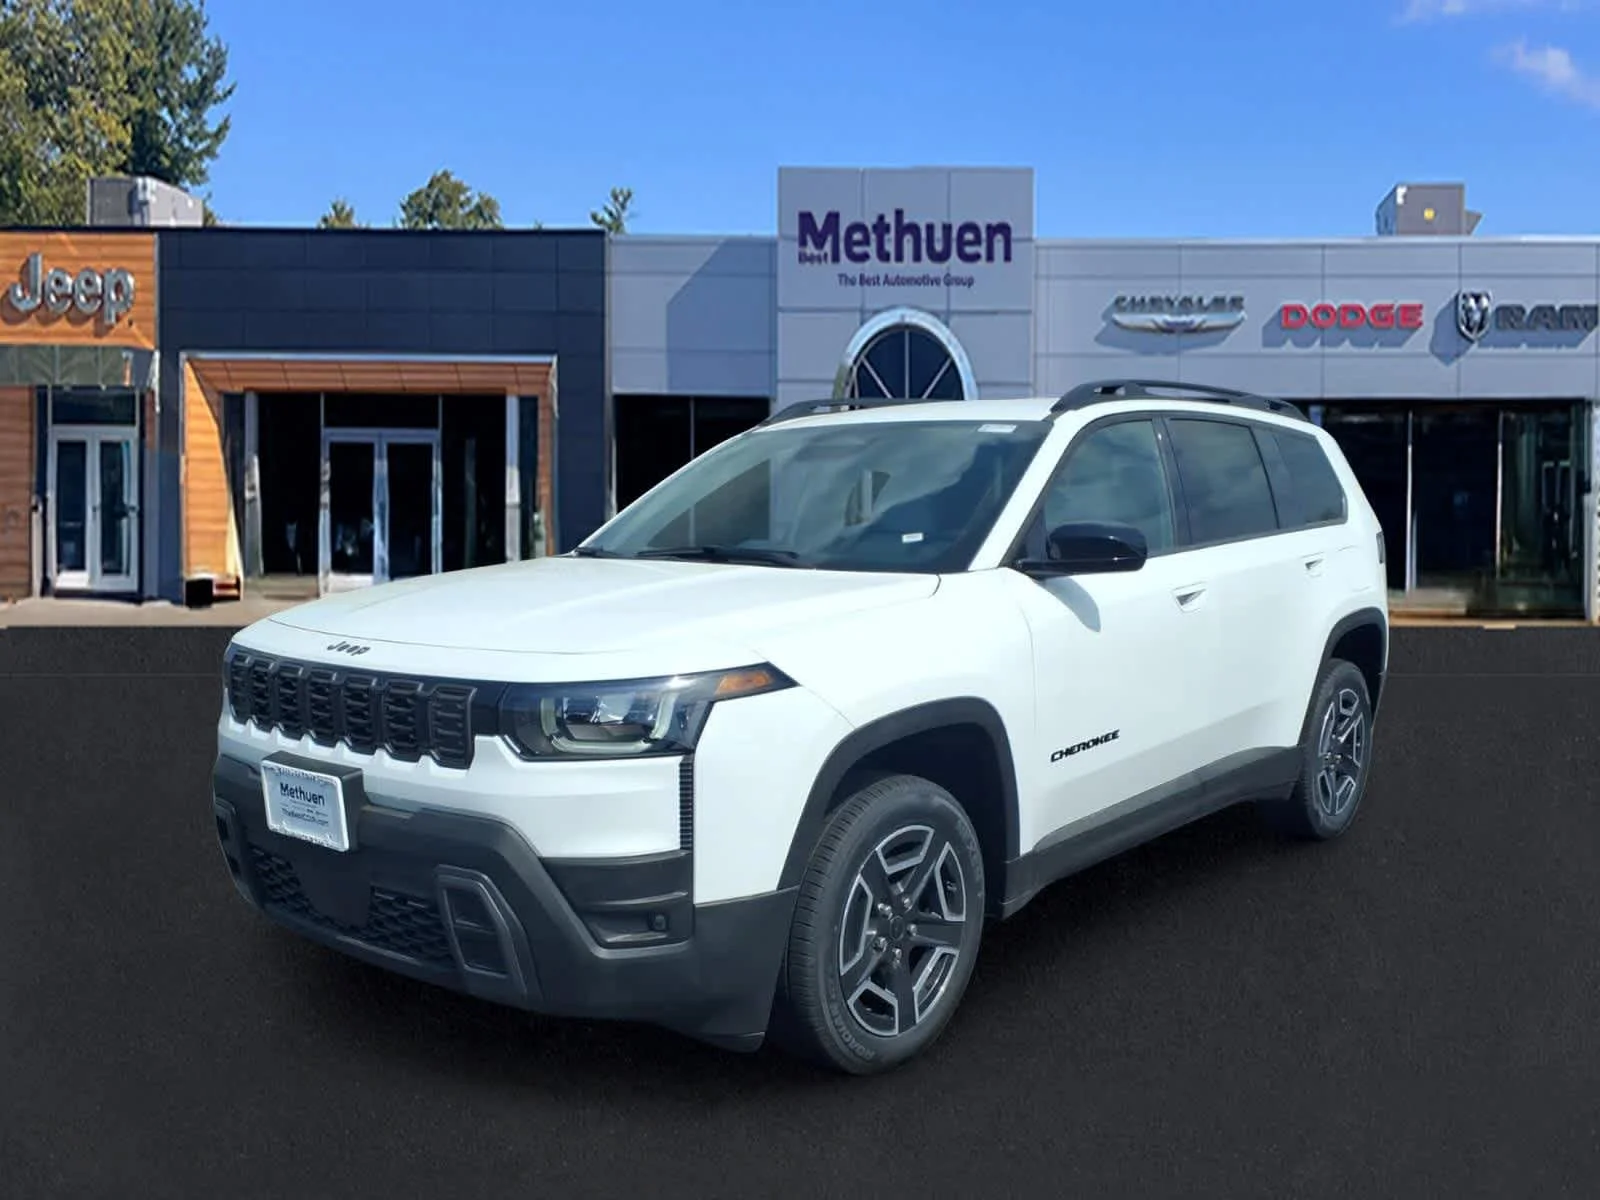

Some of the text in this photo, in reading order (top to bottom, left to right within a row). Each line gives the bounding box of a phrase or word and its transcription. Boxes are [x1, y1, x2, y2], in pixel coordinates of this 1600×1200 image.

[798, 208, 1012, 263] Methuen
[9, 252, 136, 325] Jeep
[838, 273, 974, 288] The Best Automotive Group
[1114, 296, 1244, 312] CHRYSLER
[1281, 304, 1423, 329] DODGE
[1495, 305, 1599, 332] RAM
[326, 641, 371, 656] Jeep
[1050, 728, 1120, 762] CHEROKEE
[280, 783, 325, 805] Methuen
